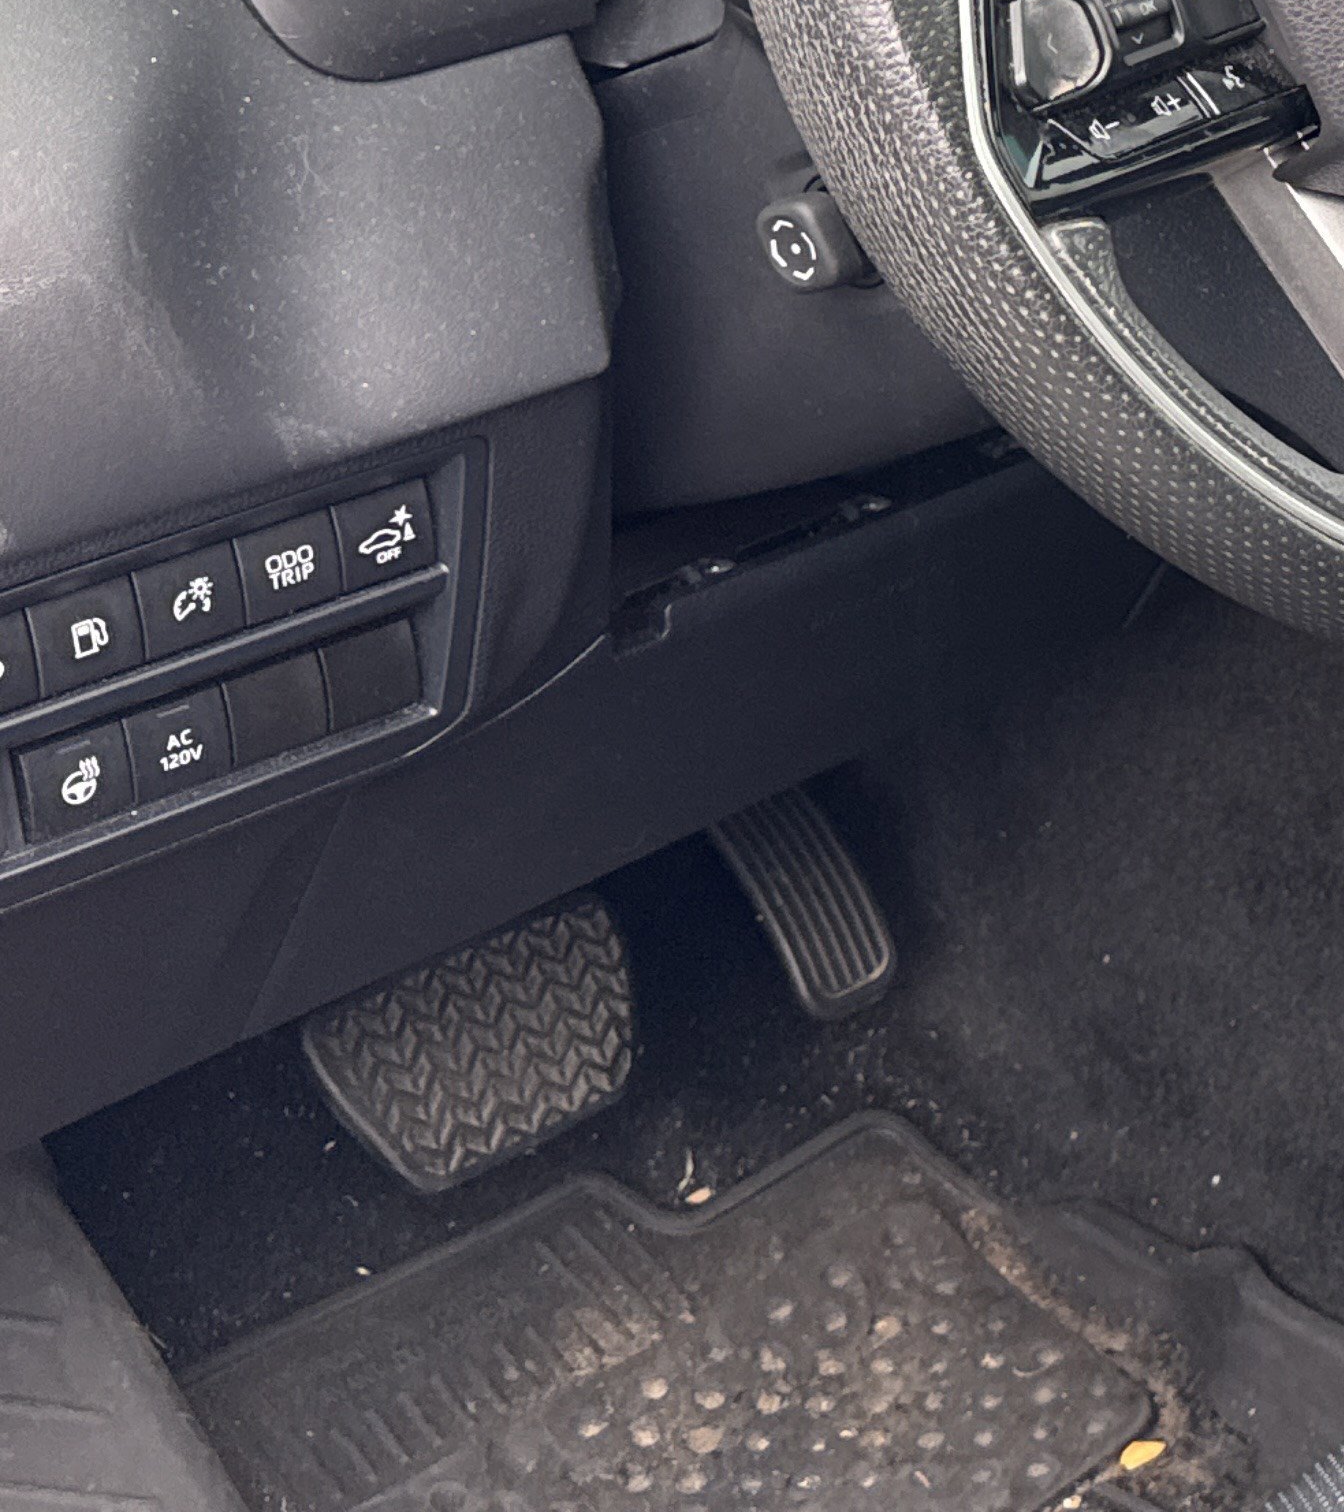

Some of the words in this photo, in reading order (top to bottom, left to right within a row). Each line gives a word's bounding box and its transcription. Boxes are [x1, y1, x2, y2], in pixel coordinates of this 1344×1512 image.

[264, 543, 315, 575] ODO
[375, 547, 402, 565] OFF
[269, 562, 315, 590] TRIP
[166, 729, 194, 751] AC
[160, 744, 203, 772] 120V
